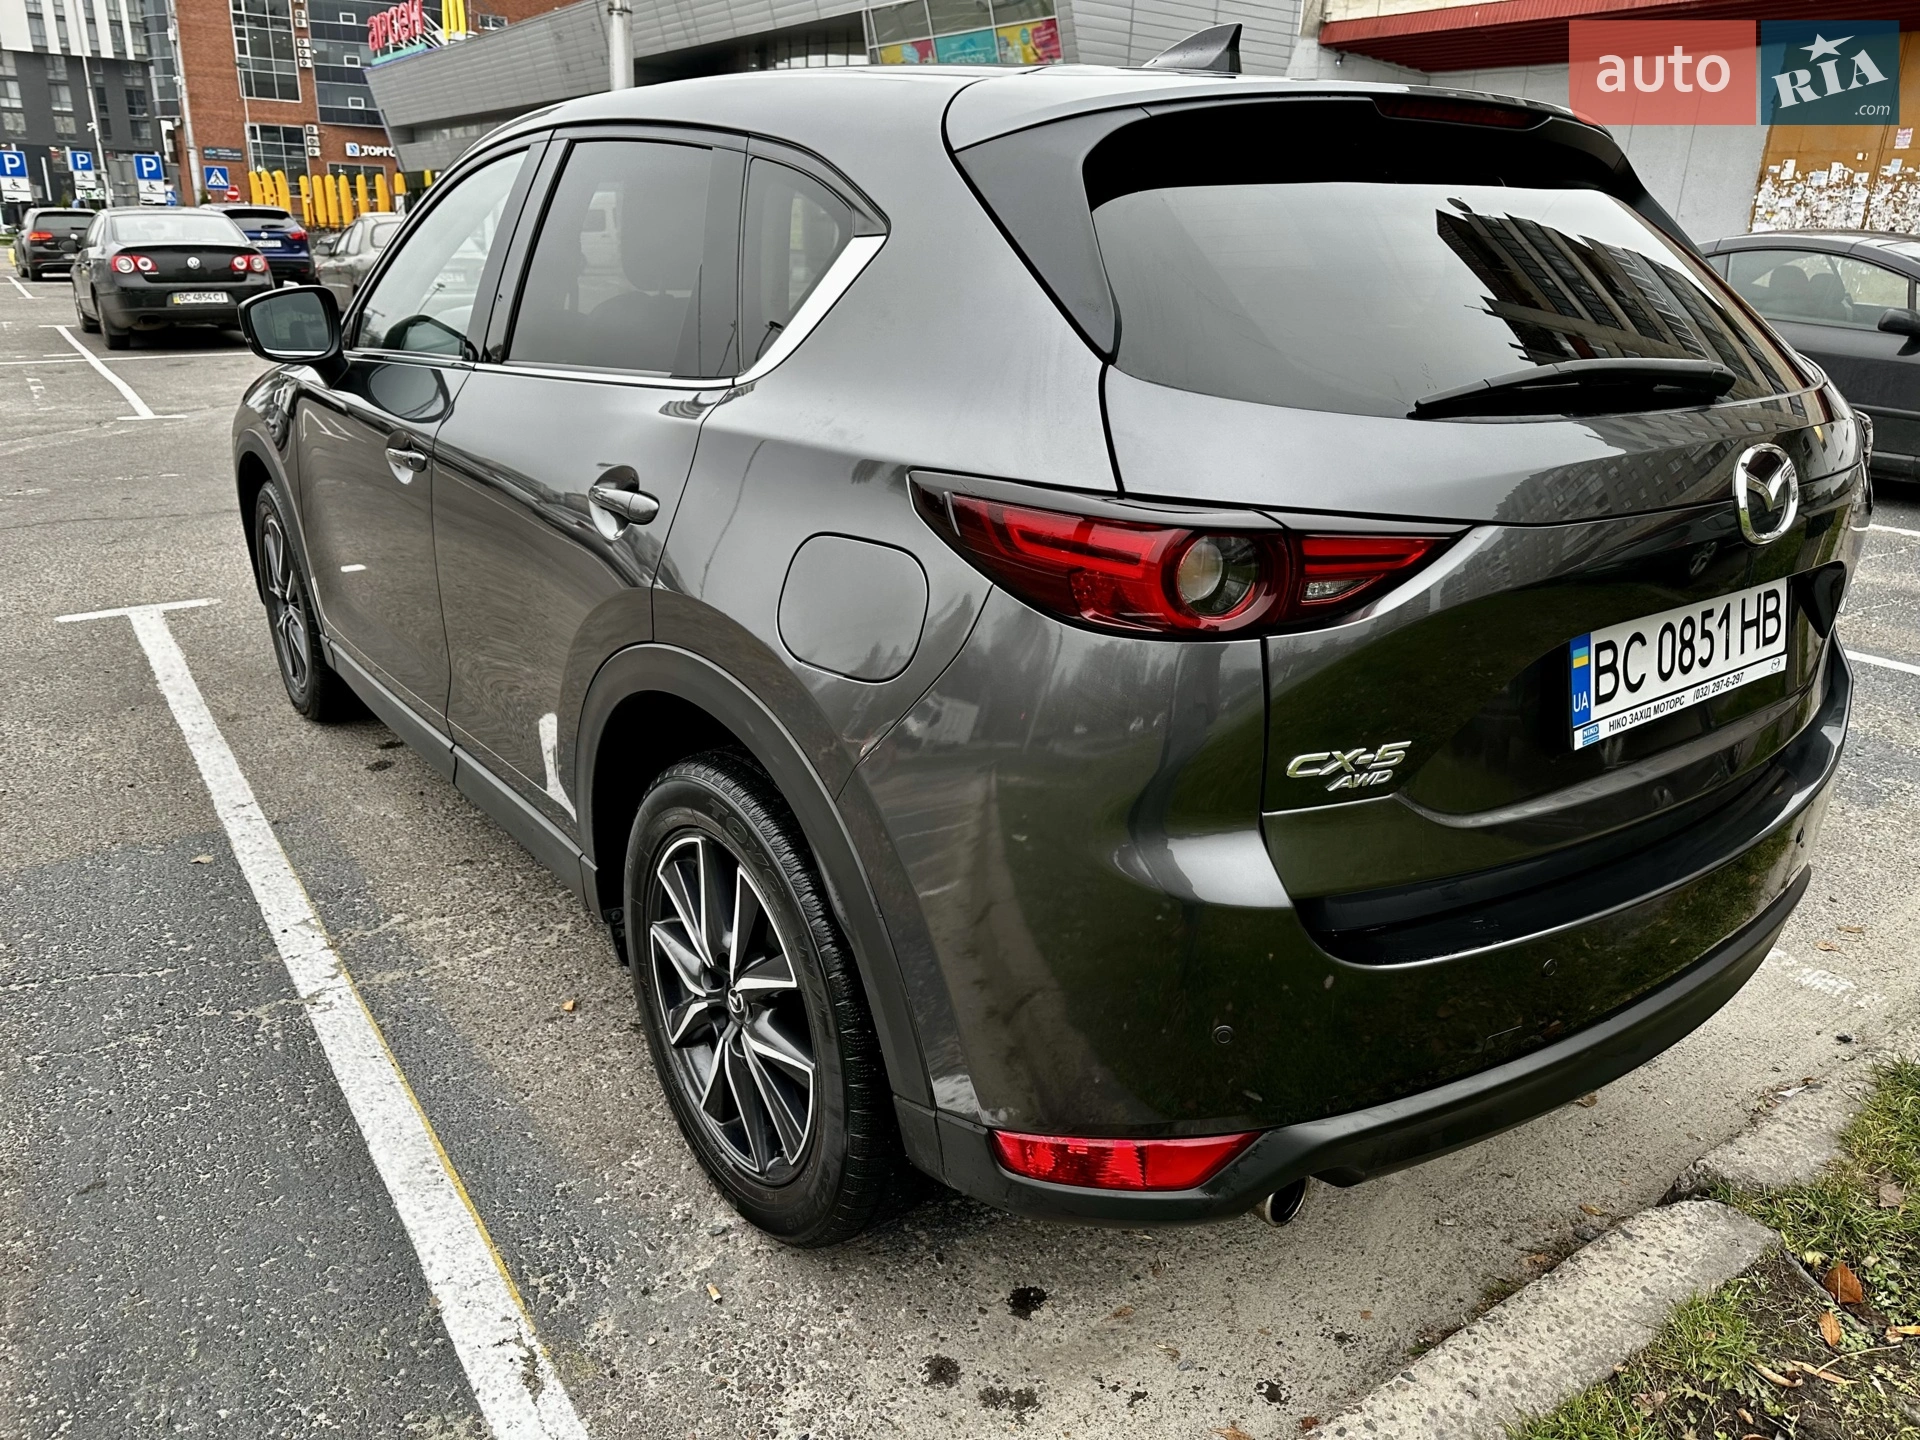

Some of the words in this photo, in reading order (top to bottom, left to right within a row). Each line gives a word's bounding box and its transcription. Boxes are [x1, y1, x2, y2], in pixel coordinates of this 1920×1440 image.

[3, 153, 21, 175] P
[77, 154, 88, 169] P
[142, 157, 157, 177] P
[178, 293, 191, 302] BC
[1595, 631, 1647, 706] BC
[1657, 602, 1731, 682] 0851
[1740, 588, 1782, 655] HB
[1573, 691, 1589, 713] UA
[1609, 715, 1628, 732] НІКО
[1629, 706, 1651, 725] ЗАХІД
[1653, 695, 1685, 715] МОТОРС
[1693, 684, 1711, 702] (032)
[1711, 672, 1744, 694] 297-6-297
[1287, 740, 1412, 778] CX-5
[1325, 769, 1394, 792] AWD
